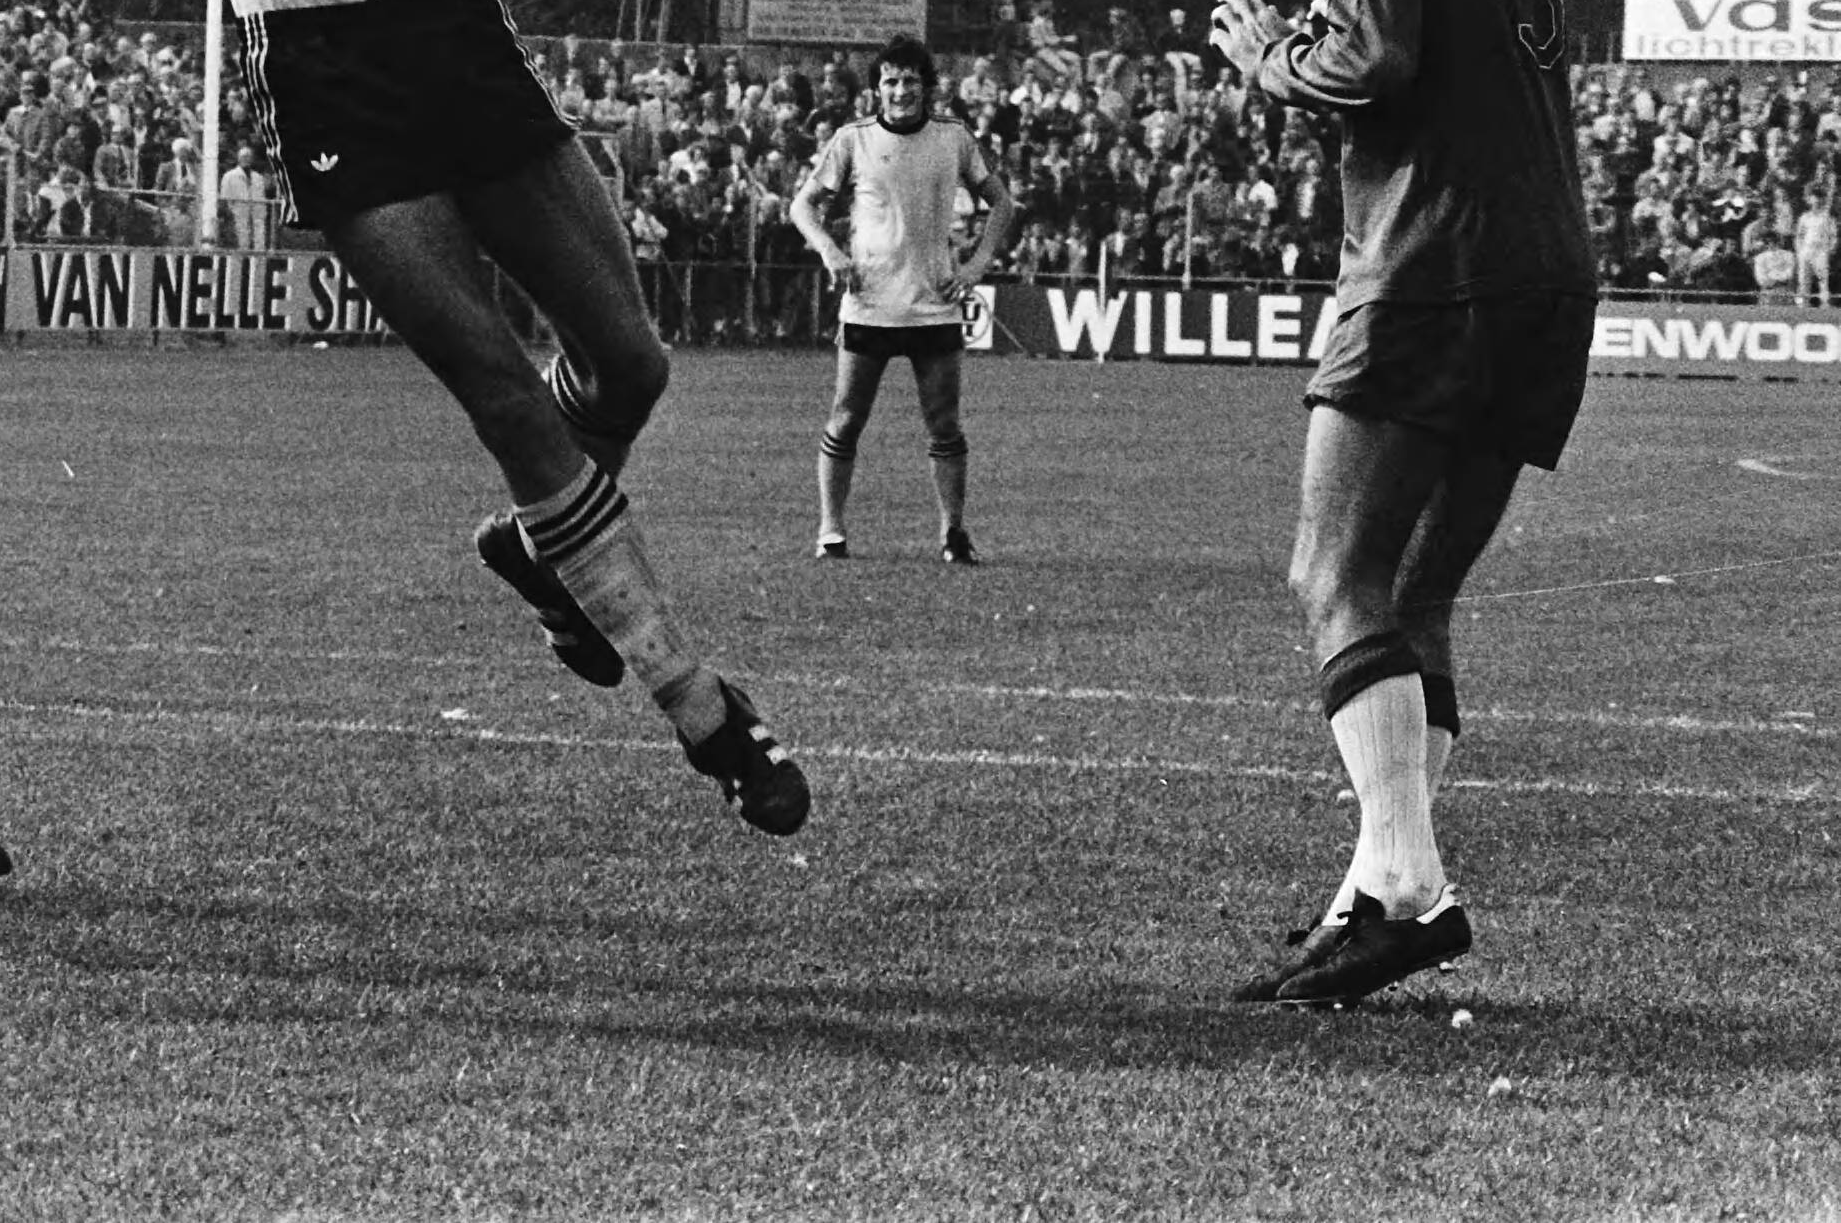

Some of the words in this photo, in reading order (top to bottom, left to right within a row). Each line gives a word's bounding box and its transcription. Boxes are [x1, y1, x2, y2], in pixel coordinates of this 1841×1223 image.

[32, 252, 133, 328] VAN
[150, 254, 294, 330] NELLE
[307, 256, 383, 332] SH
